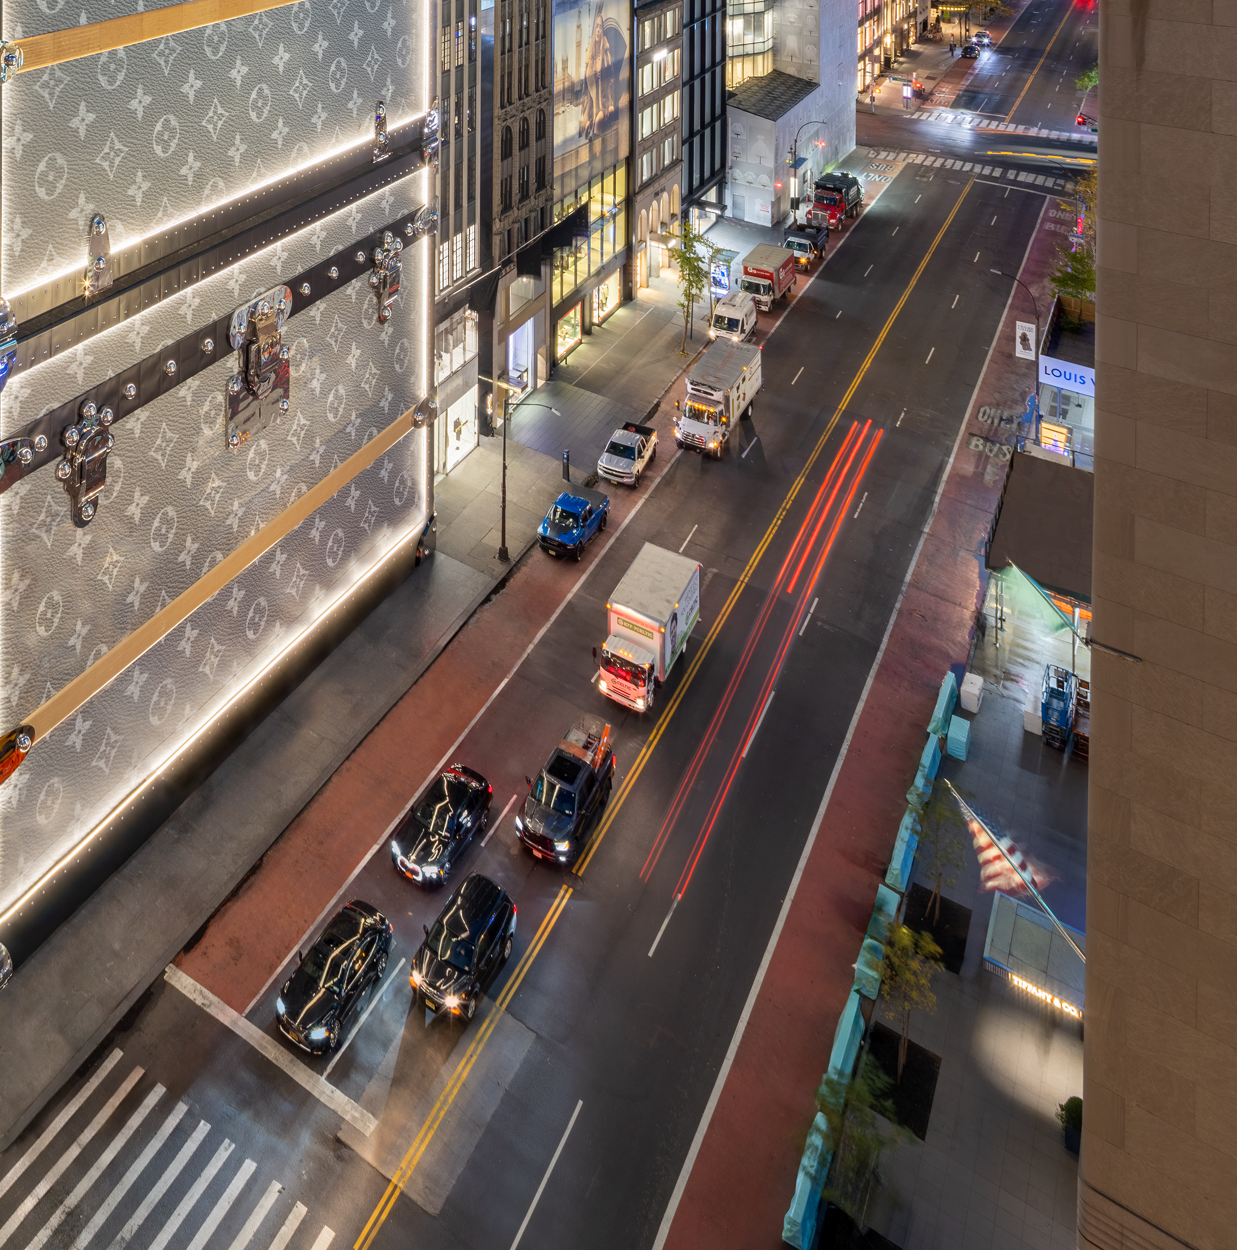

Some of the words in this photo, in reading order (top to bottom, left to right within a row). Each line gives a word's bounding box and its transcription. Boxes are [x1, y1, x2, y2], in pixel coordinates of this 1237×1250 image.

[869, 162, 895, 172] BUS
[861, 172, 893, 183] ONLY
[1044, 365, 1086, 385] LOUIS
